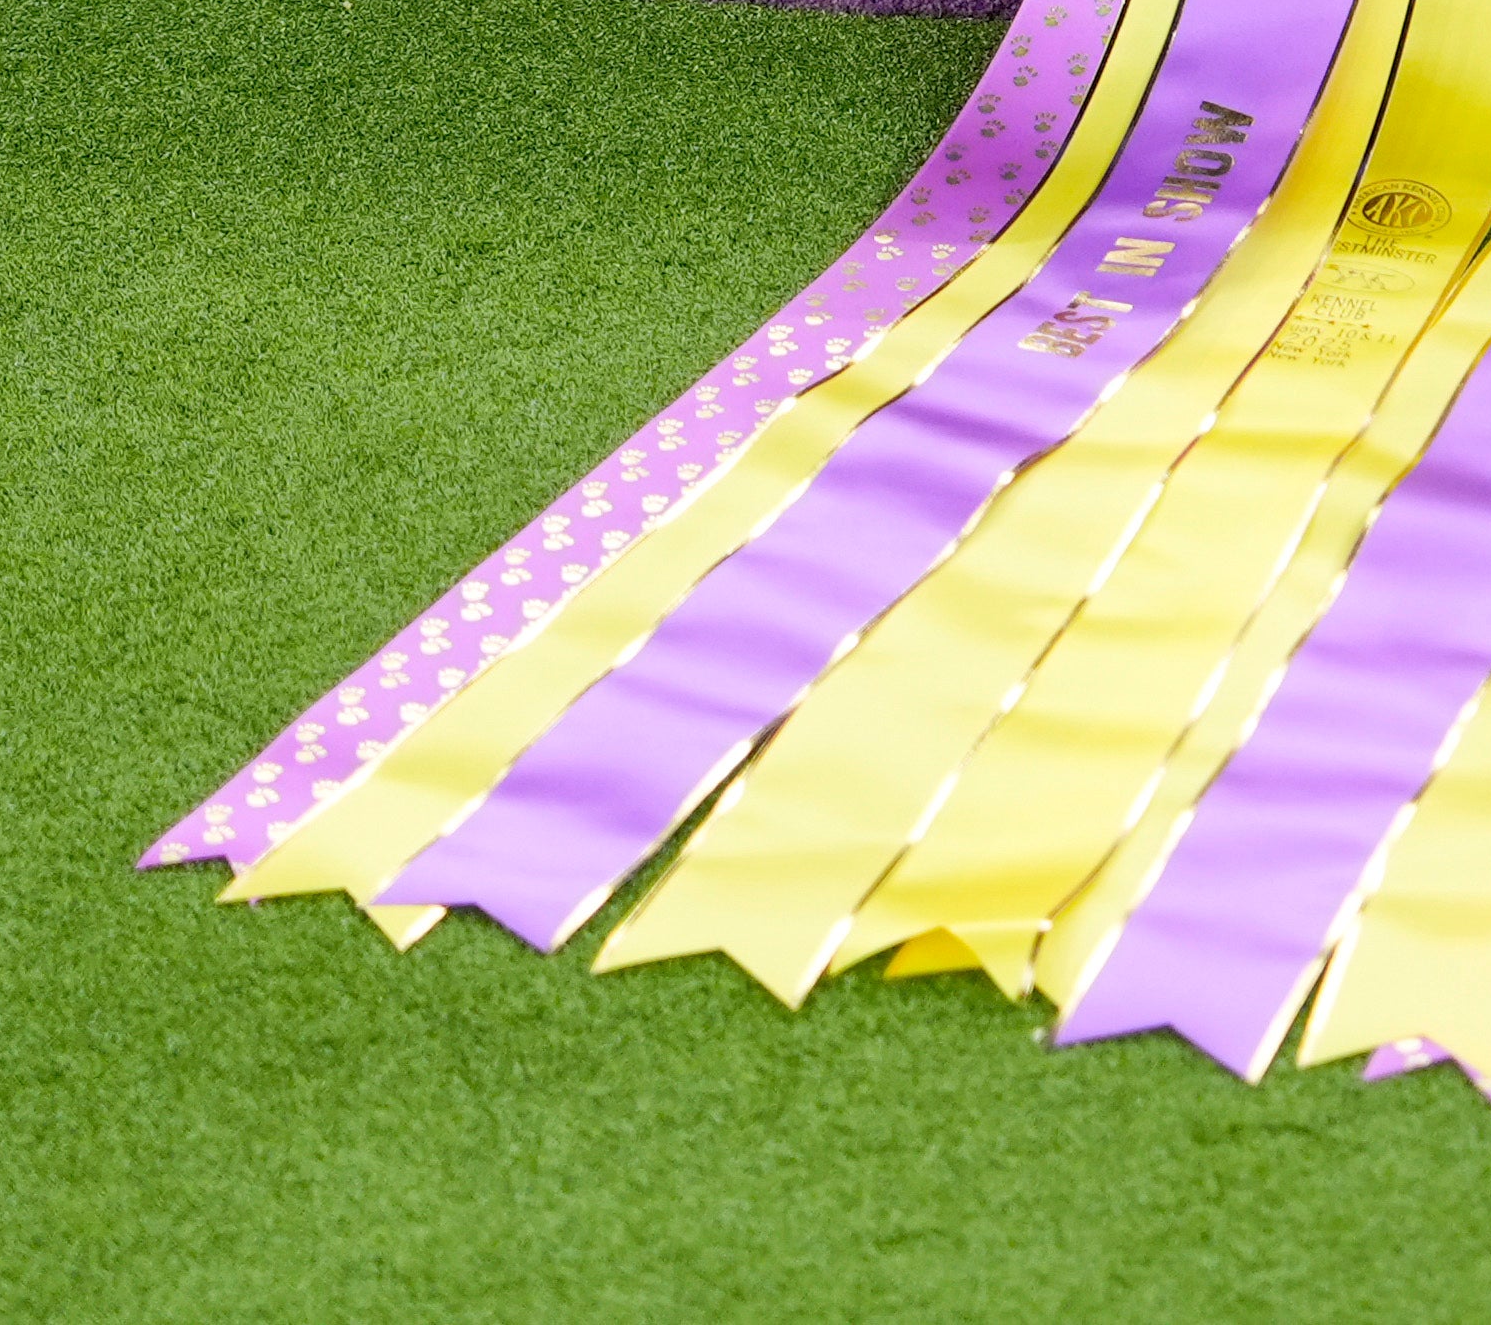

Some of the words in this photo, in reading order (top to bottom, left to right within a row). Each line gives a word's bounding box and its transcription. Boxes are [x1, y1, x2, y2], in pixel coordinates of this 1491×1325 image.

[1364, 192, 1430, 228] AKC
[1017, 290, 1134, 358] BEST
[1095, 236, 1176, 277] IN
[1142, 100, 1255, 223] SHOW
[1362, 234, 1402, 248] THE
[1310, 293, 1377, 312] KENNEL
[1314, 306, 1367, 320] CLUB
